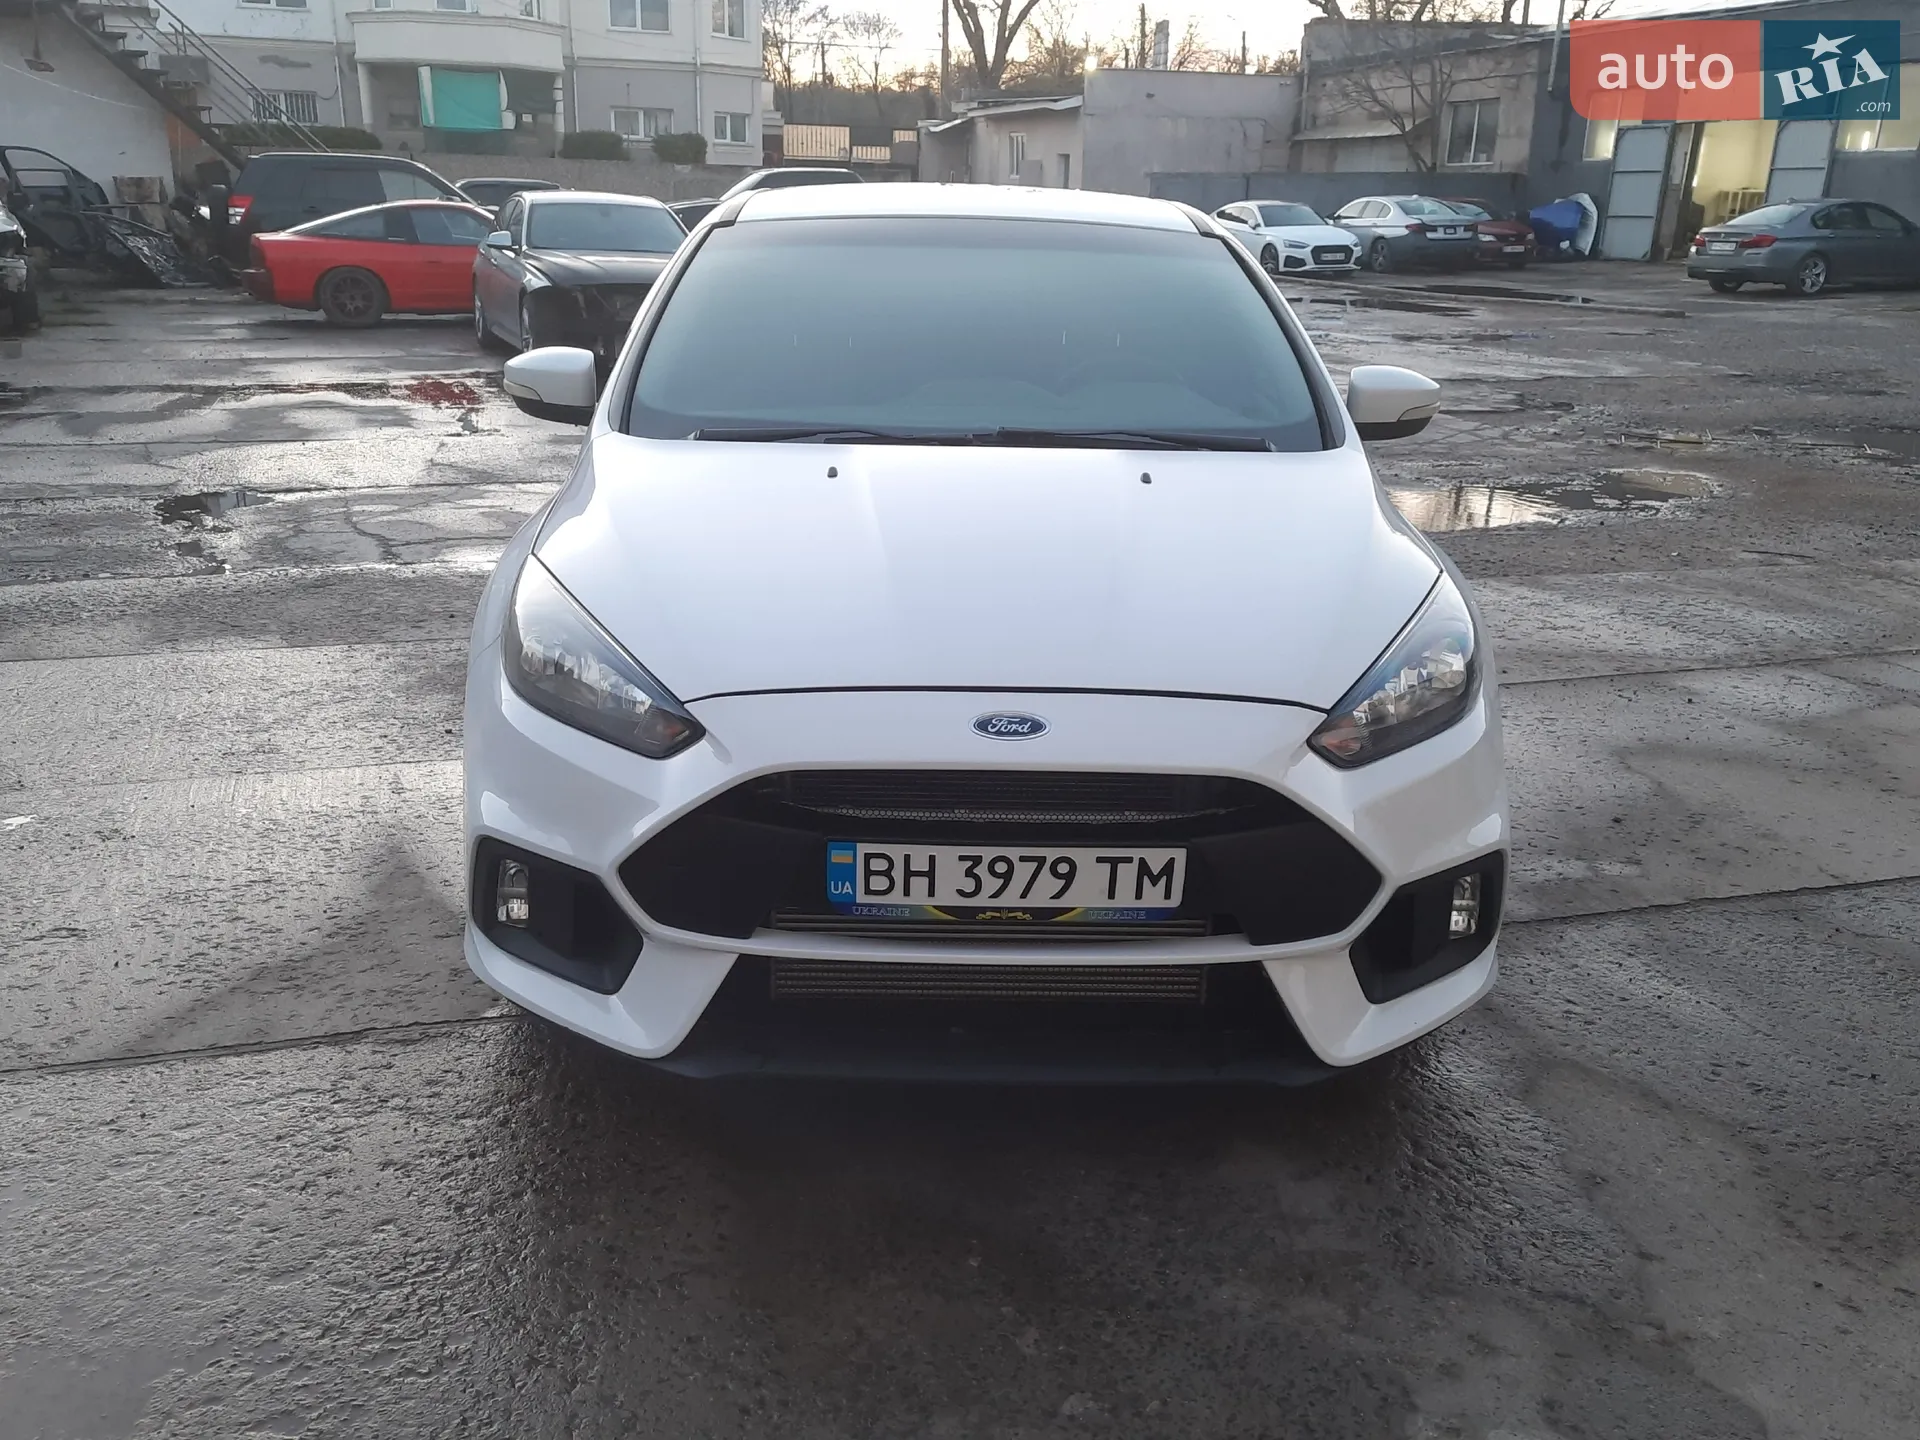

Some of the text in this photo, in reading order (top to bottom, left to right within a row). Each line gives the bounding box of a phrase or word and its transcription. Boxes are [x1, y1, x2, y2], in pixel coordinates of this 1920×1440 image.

[987, 717, 1032, 733] Ford
[863, 852, 1176, 901] BH 3979 TM
[830, 881, 853, 895] UA
[852, 905, 911, 917] UKRAINE
[1088, 910, 1147, 920] UKRAINE
